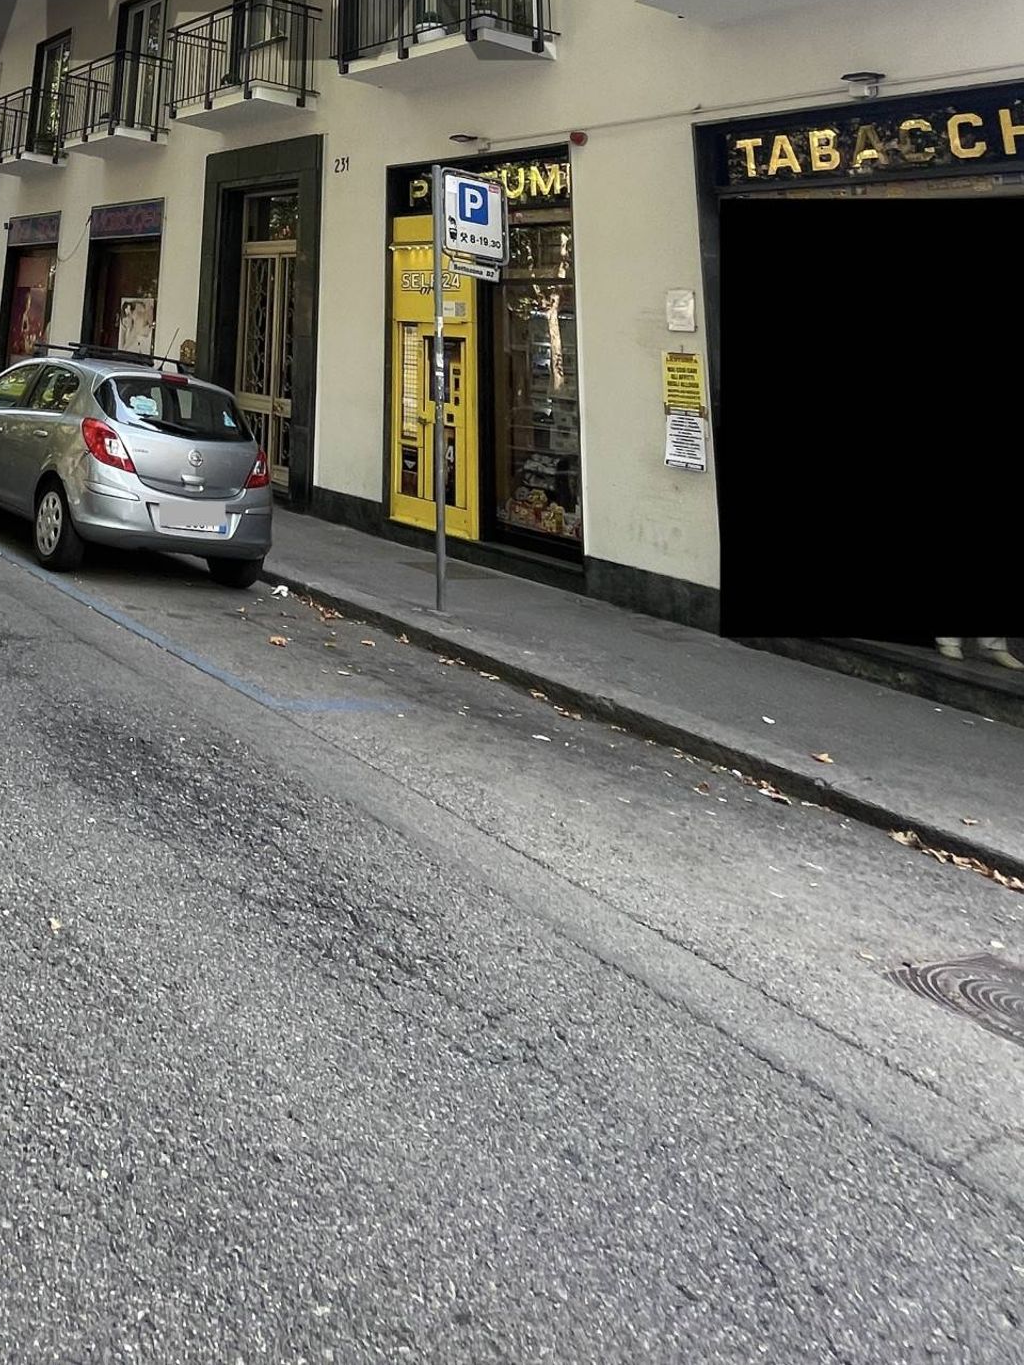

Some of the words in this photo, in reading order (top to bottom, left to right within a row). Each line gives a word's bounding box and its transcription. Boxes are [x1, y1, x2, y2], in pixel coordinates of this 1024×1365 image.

[334, 156, 349, 173] 231
[464, 186, 484, 219] P
[441, 272, 461, 289] 24
